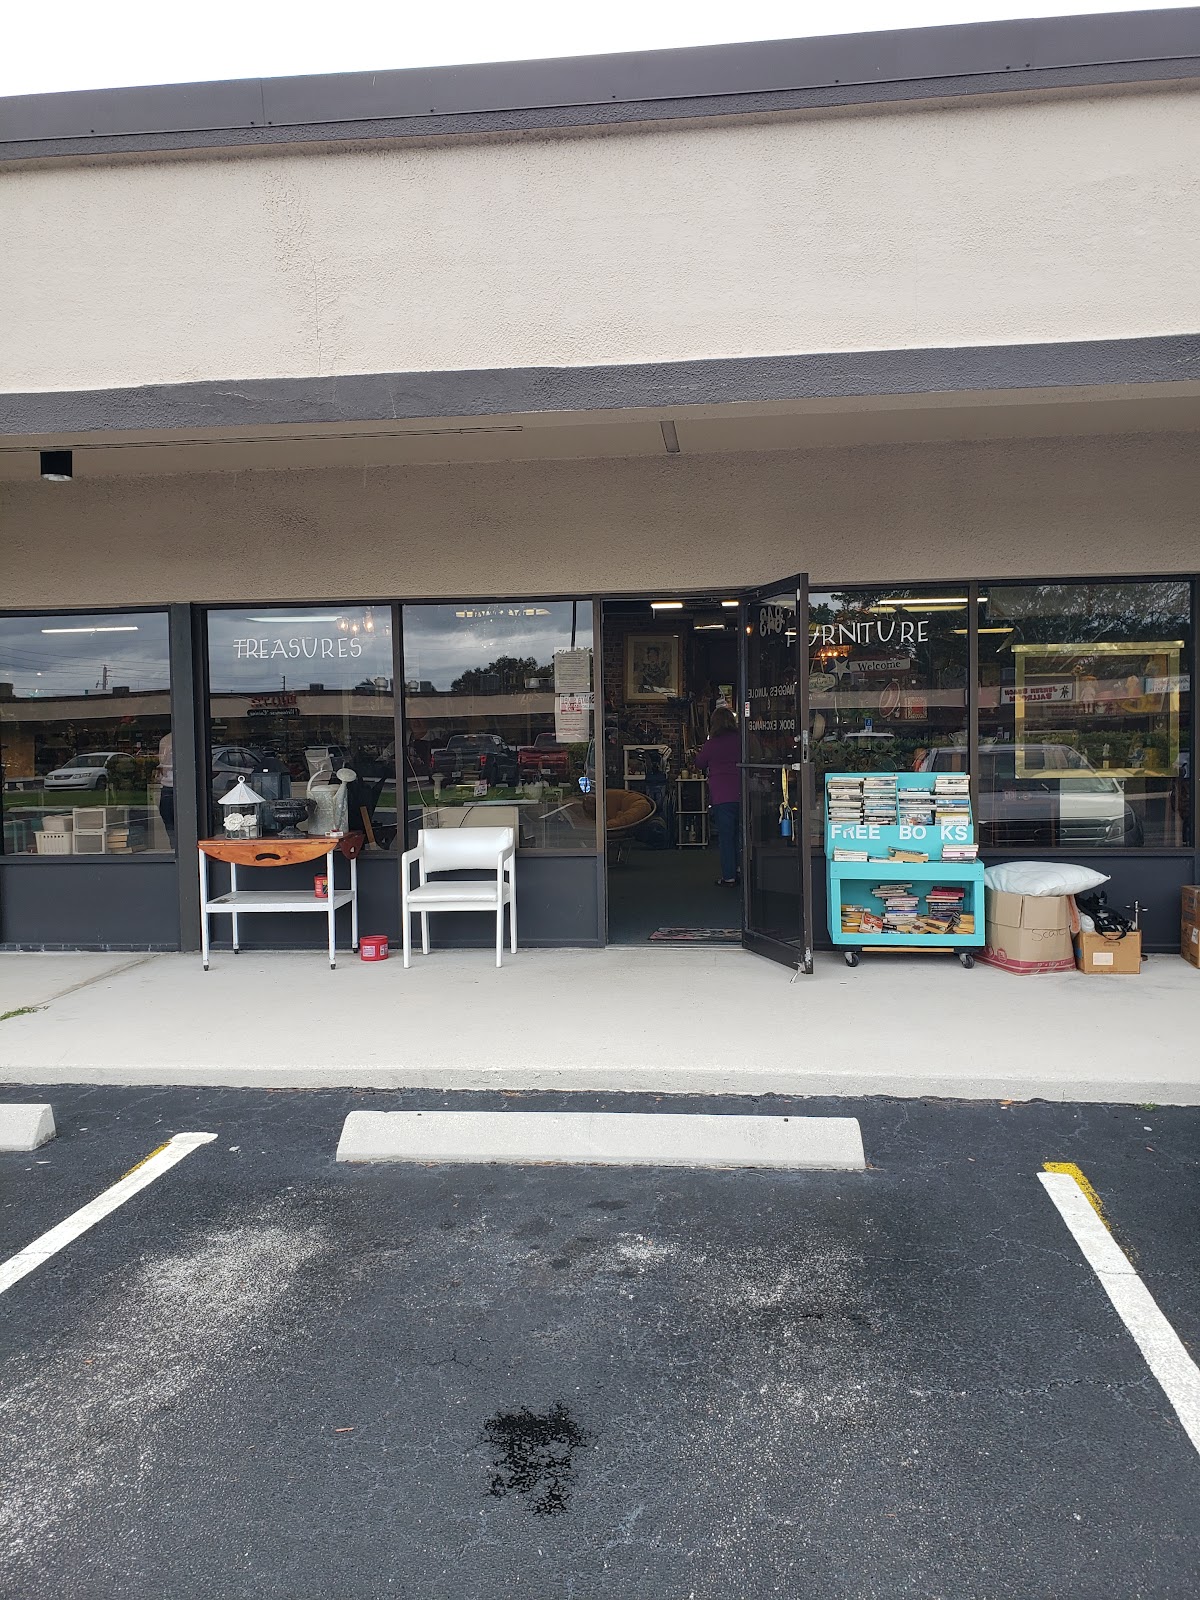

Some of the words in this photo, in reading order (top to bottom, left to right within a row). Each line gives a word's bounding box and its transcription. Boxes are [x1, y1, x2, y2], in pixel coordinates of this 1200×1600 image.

[233, 637, 362, 659] TREASURES
[857, 660, 901, 672] Welcome
[831, 824, 881, 840] FREE
